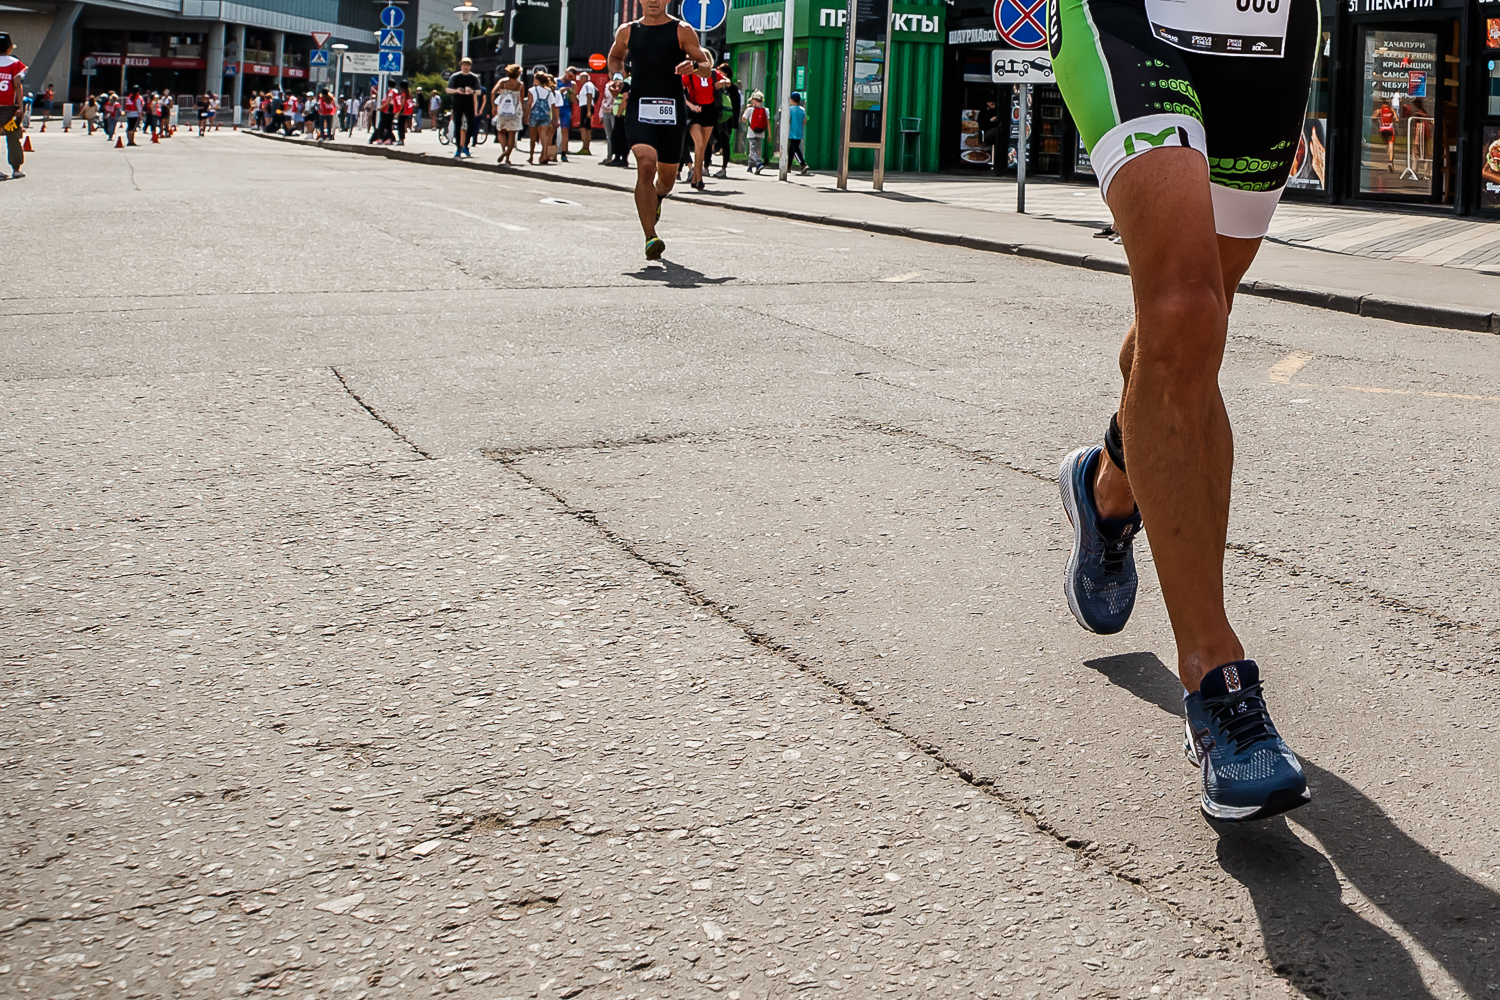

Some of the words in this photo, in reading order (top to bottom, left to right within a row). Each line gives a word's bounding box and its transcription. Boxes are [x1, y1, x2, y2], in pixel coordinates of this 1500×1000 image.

[742, 11, 783, 35] ПРОДУКТЫ
[819, 8, 939, 33] ПРКТЫ
[97, 56, 121, 65] FORTE
[125, 57, 150, 66] BELLO
[1382, 61, 1432, 69] КРЫЛЫШКИ
[1382, 71, 1409, 79] САМСА
[1382, 81, 1410, 89] ЧЕБУР
[1381, 91, 1416, 99] ШАРМА
[659, 105, 673, 115] 669
